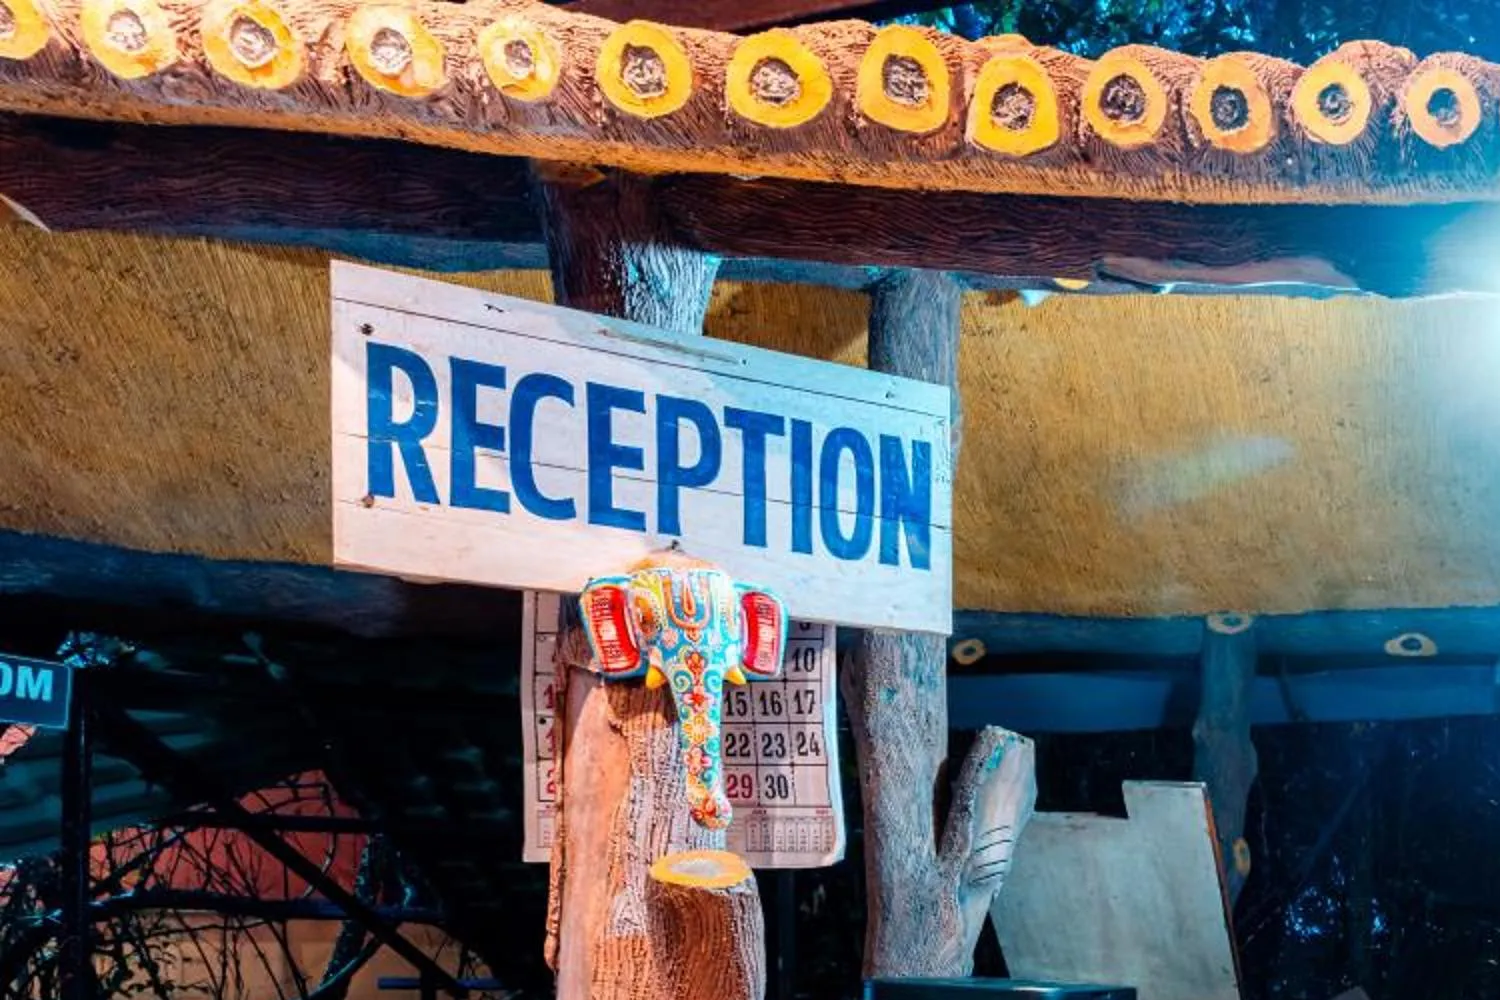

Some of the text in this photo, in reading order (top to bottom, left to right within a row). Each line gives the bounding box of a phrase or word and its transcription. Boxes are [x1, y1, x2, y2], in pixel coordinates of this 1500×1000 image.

[365, 341, 933, 571] RECEPTION
[792, 647, 815, 673] 10
[724, 689, 816, 717] 15 16 17
[725, 731, 820, 758] 22 23 24
[727, 773, 789, 800] 29 30
